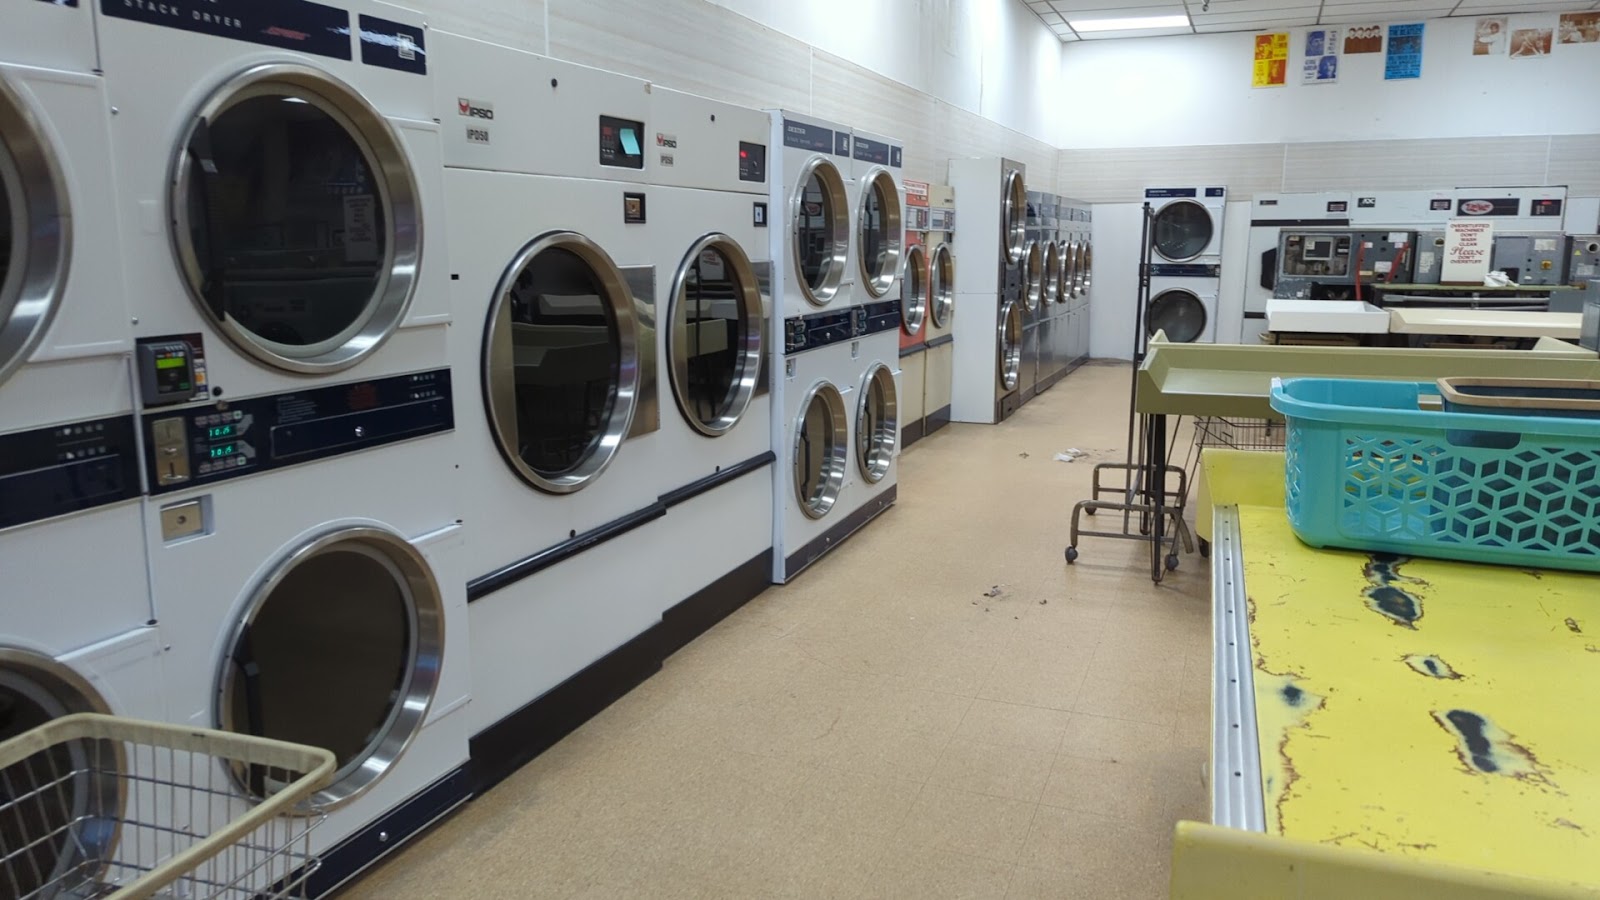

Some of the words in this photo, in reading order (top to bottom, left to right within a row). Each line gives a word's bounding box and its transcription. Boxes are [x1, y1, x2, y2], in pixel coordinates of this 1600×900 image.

[123, 0, 180, 17] STACK
[191, 10, 242, 29] DRYER
[1450, 246, 1485, 256] Please
